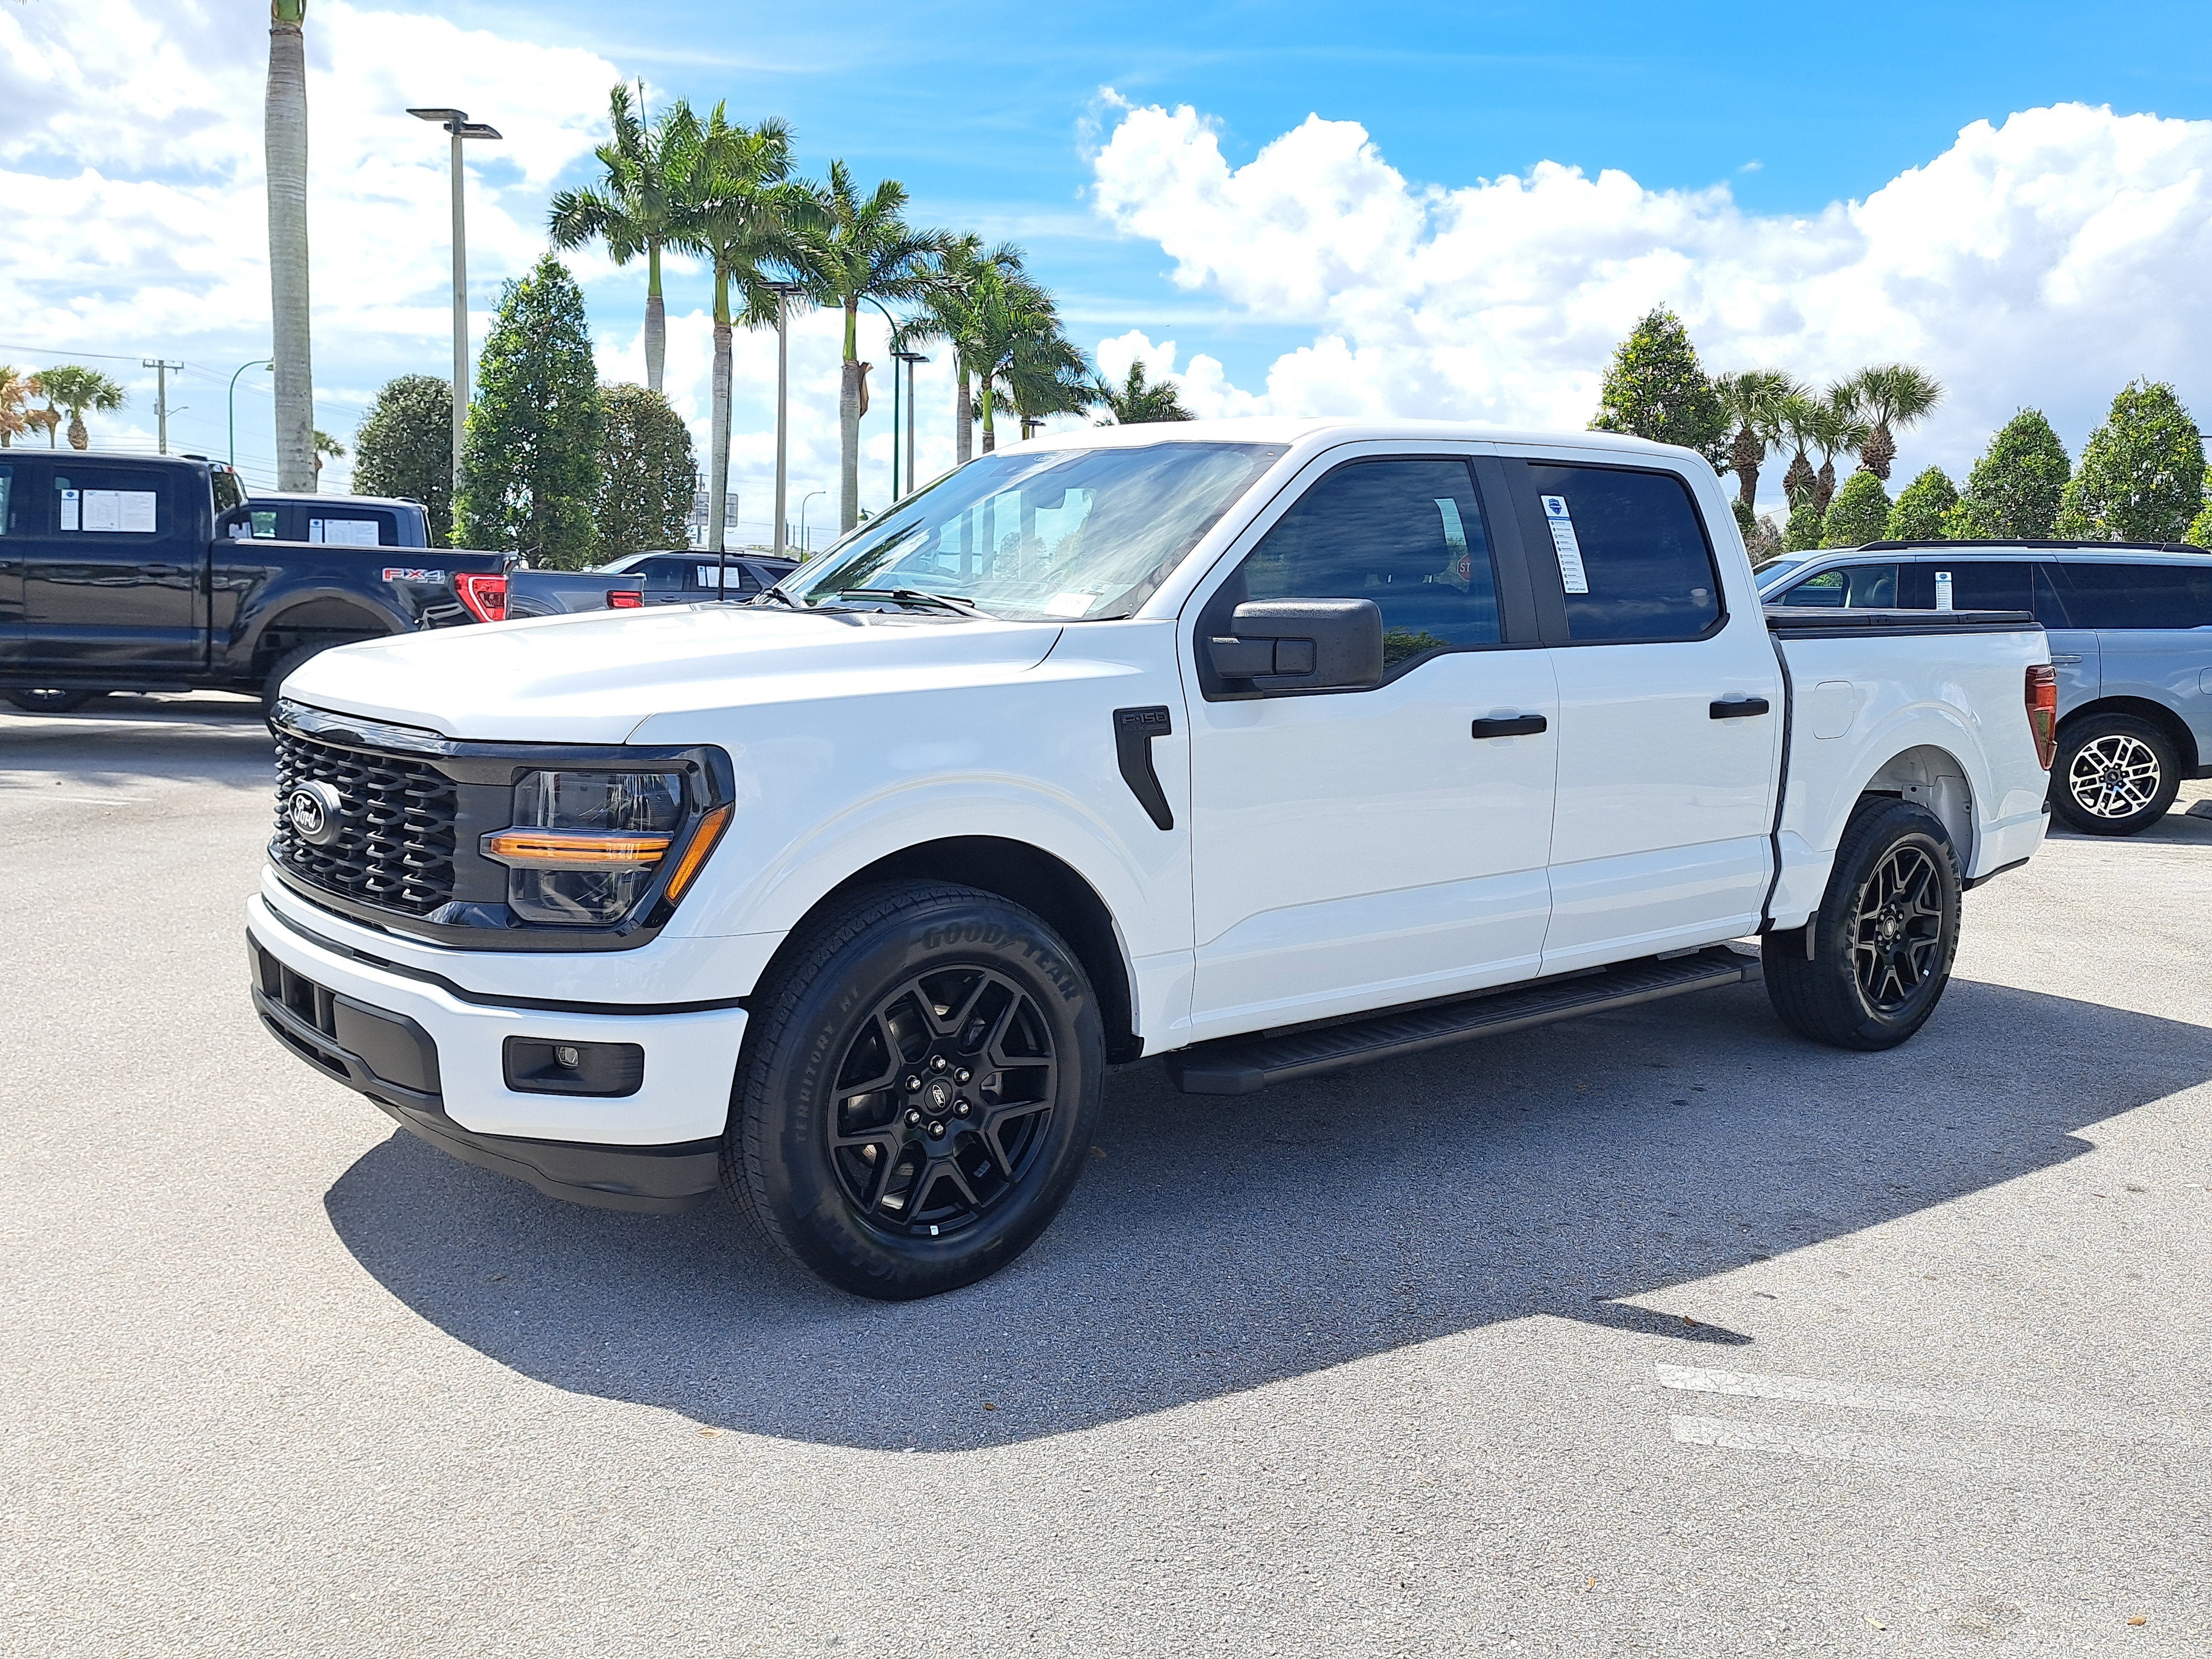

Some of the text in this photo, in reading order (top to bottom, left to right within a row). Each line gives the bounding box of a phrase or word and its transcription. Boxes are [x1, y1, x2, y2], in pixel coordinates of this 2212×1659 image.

[382, 567, 445, 584] FX4
[1460, 563, 1471, 573] ST
[1122, 711, 1167, 725] F-150
[293, 794, 317, 830] Ford
[795, 1020, 834, 1144] TERRITORY
[933, 1089, 944, 1105] Ford
